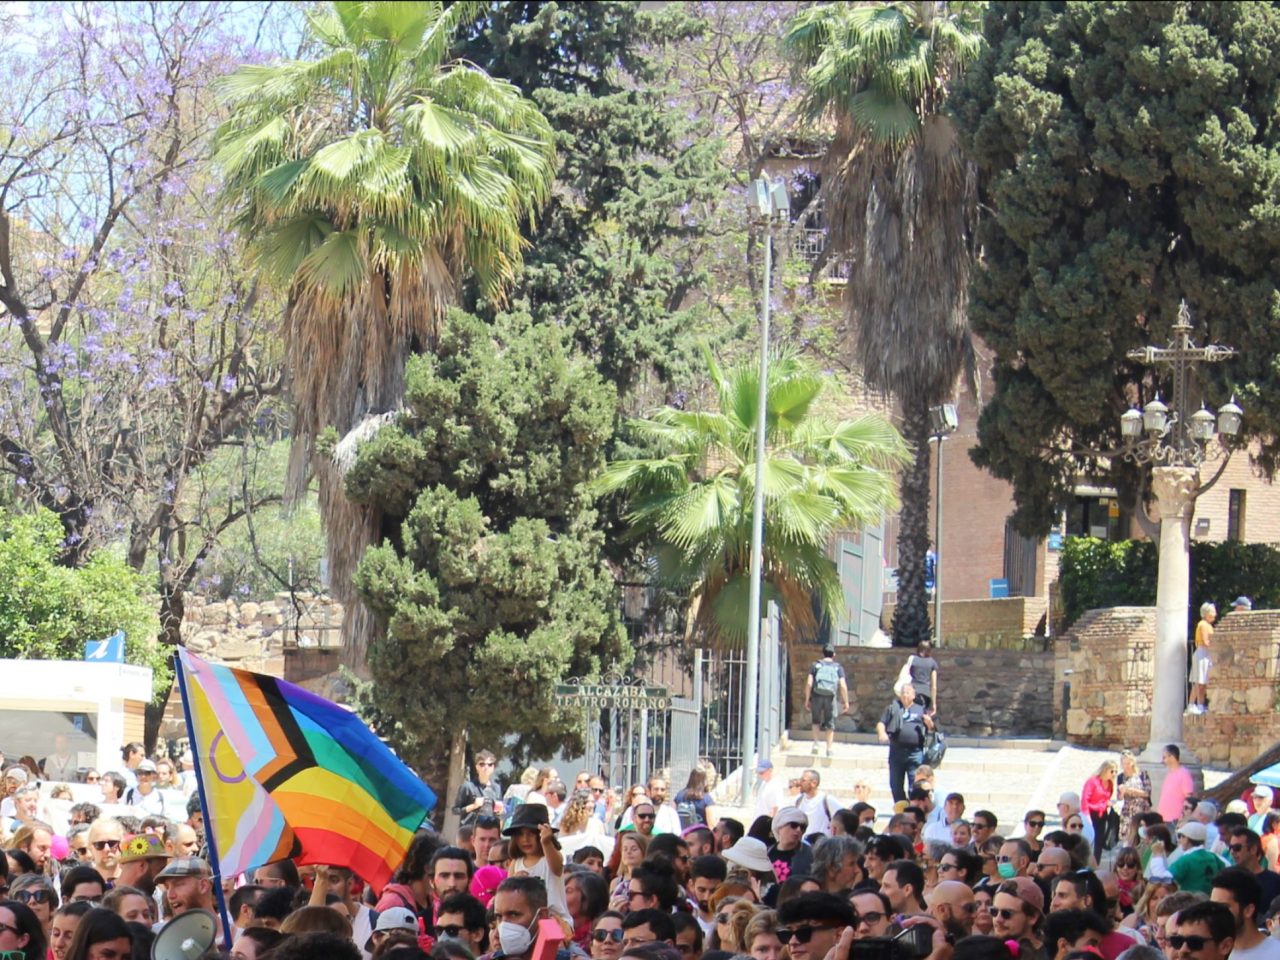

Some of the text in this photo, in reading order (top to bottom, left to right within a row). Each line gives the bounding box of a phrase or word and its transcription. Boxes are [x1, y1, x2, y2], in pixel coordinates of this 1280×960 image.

[577, 685, 647, 697] ALCAZABA
[556, 696, 666, 709] TEATRO ROMANO
